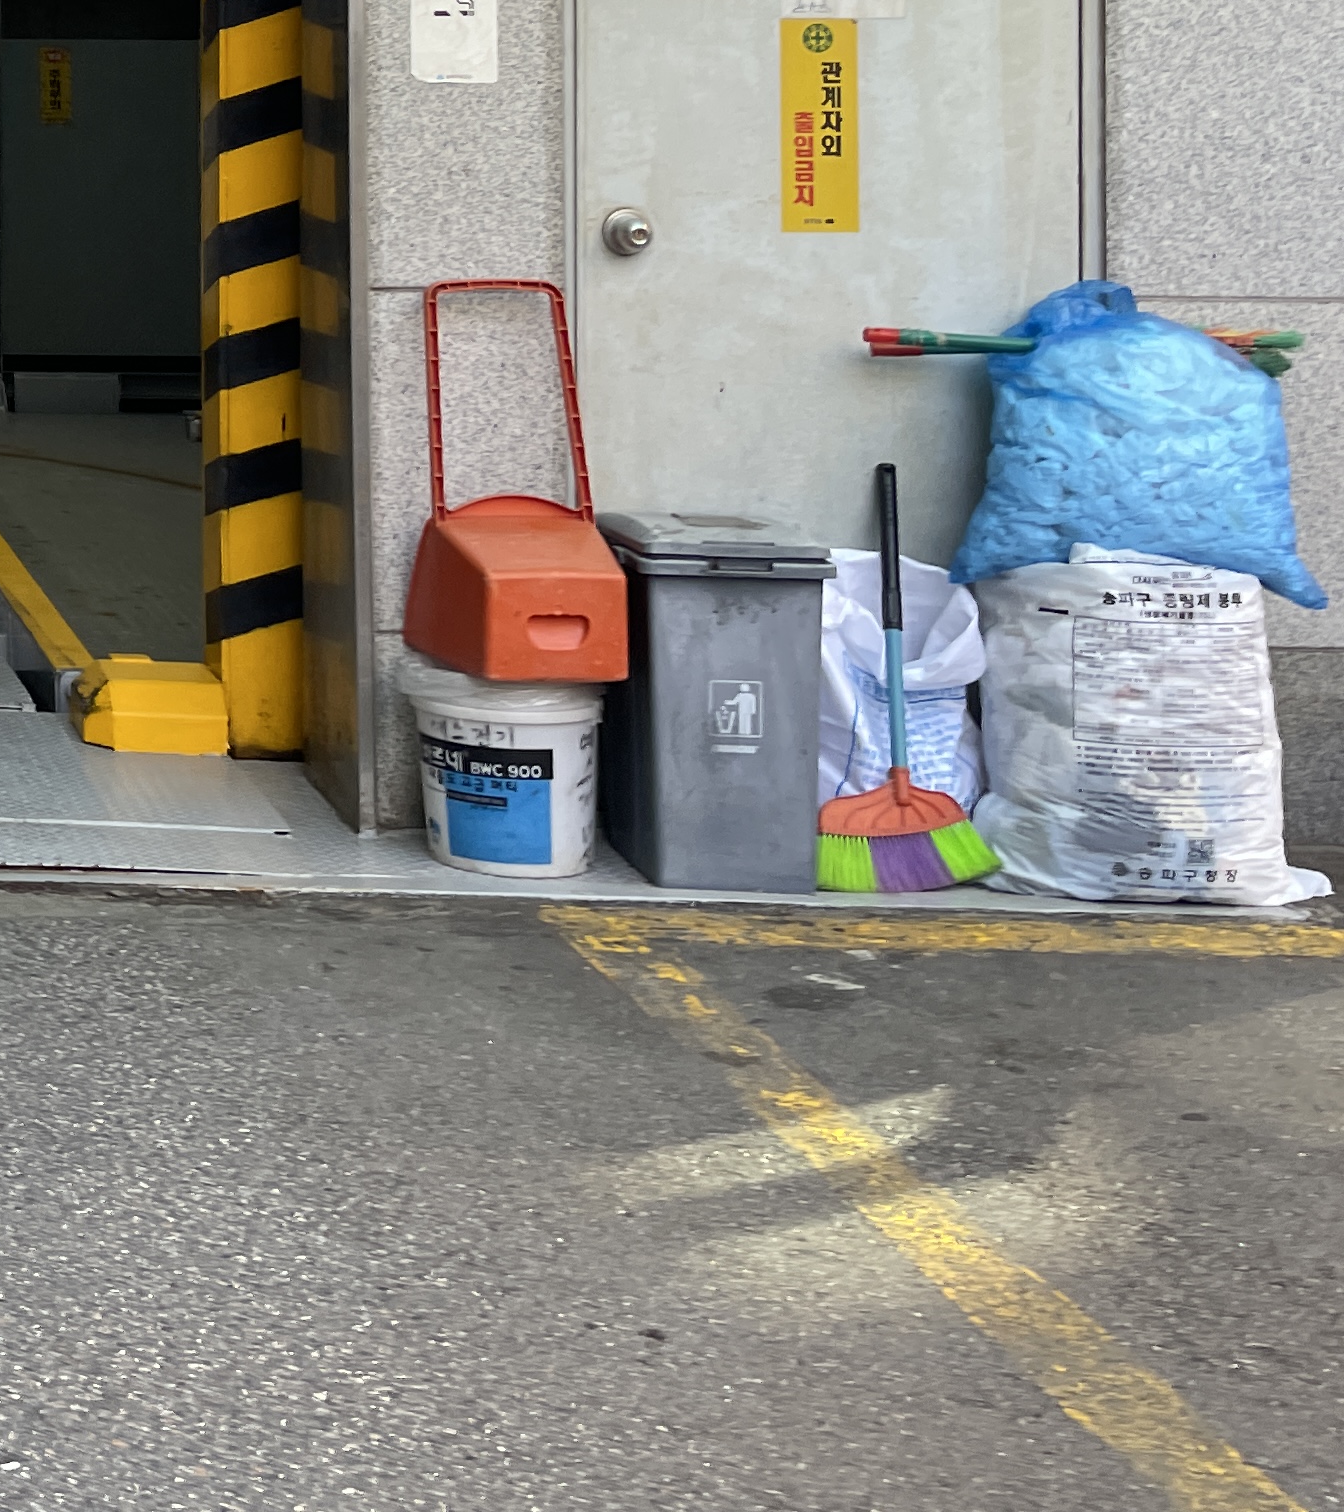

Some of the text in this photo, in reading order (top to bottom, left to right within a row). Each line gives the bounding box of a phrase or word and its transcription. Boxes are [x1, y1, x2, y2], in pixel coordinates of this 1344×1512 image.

[821, 61, 843, 157] 관계자외
[793, 111, 815, 207] 출입금지
[1101, 591, 1243, 609] 송파구 종량제 봉투
[470, 761, 542, 779] BWC 900
